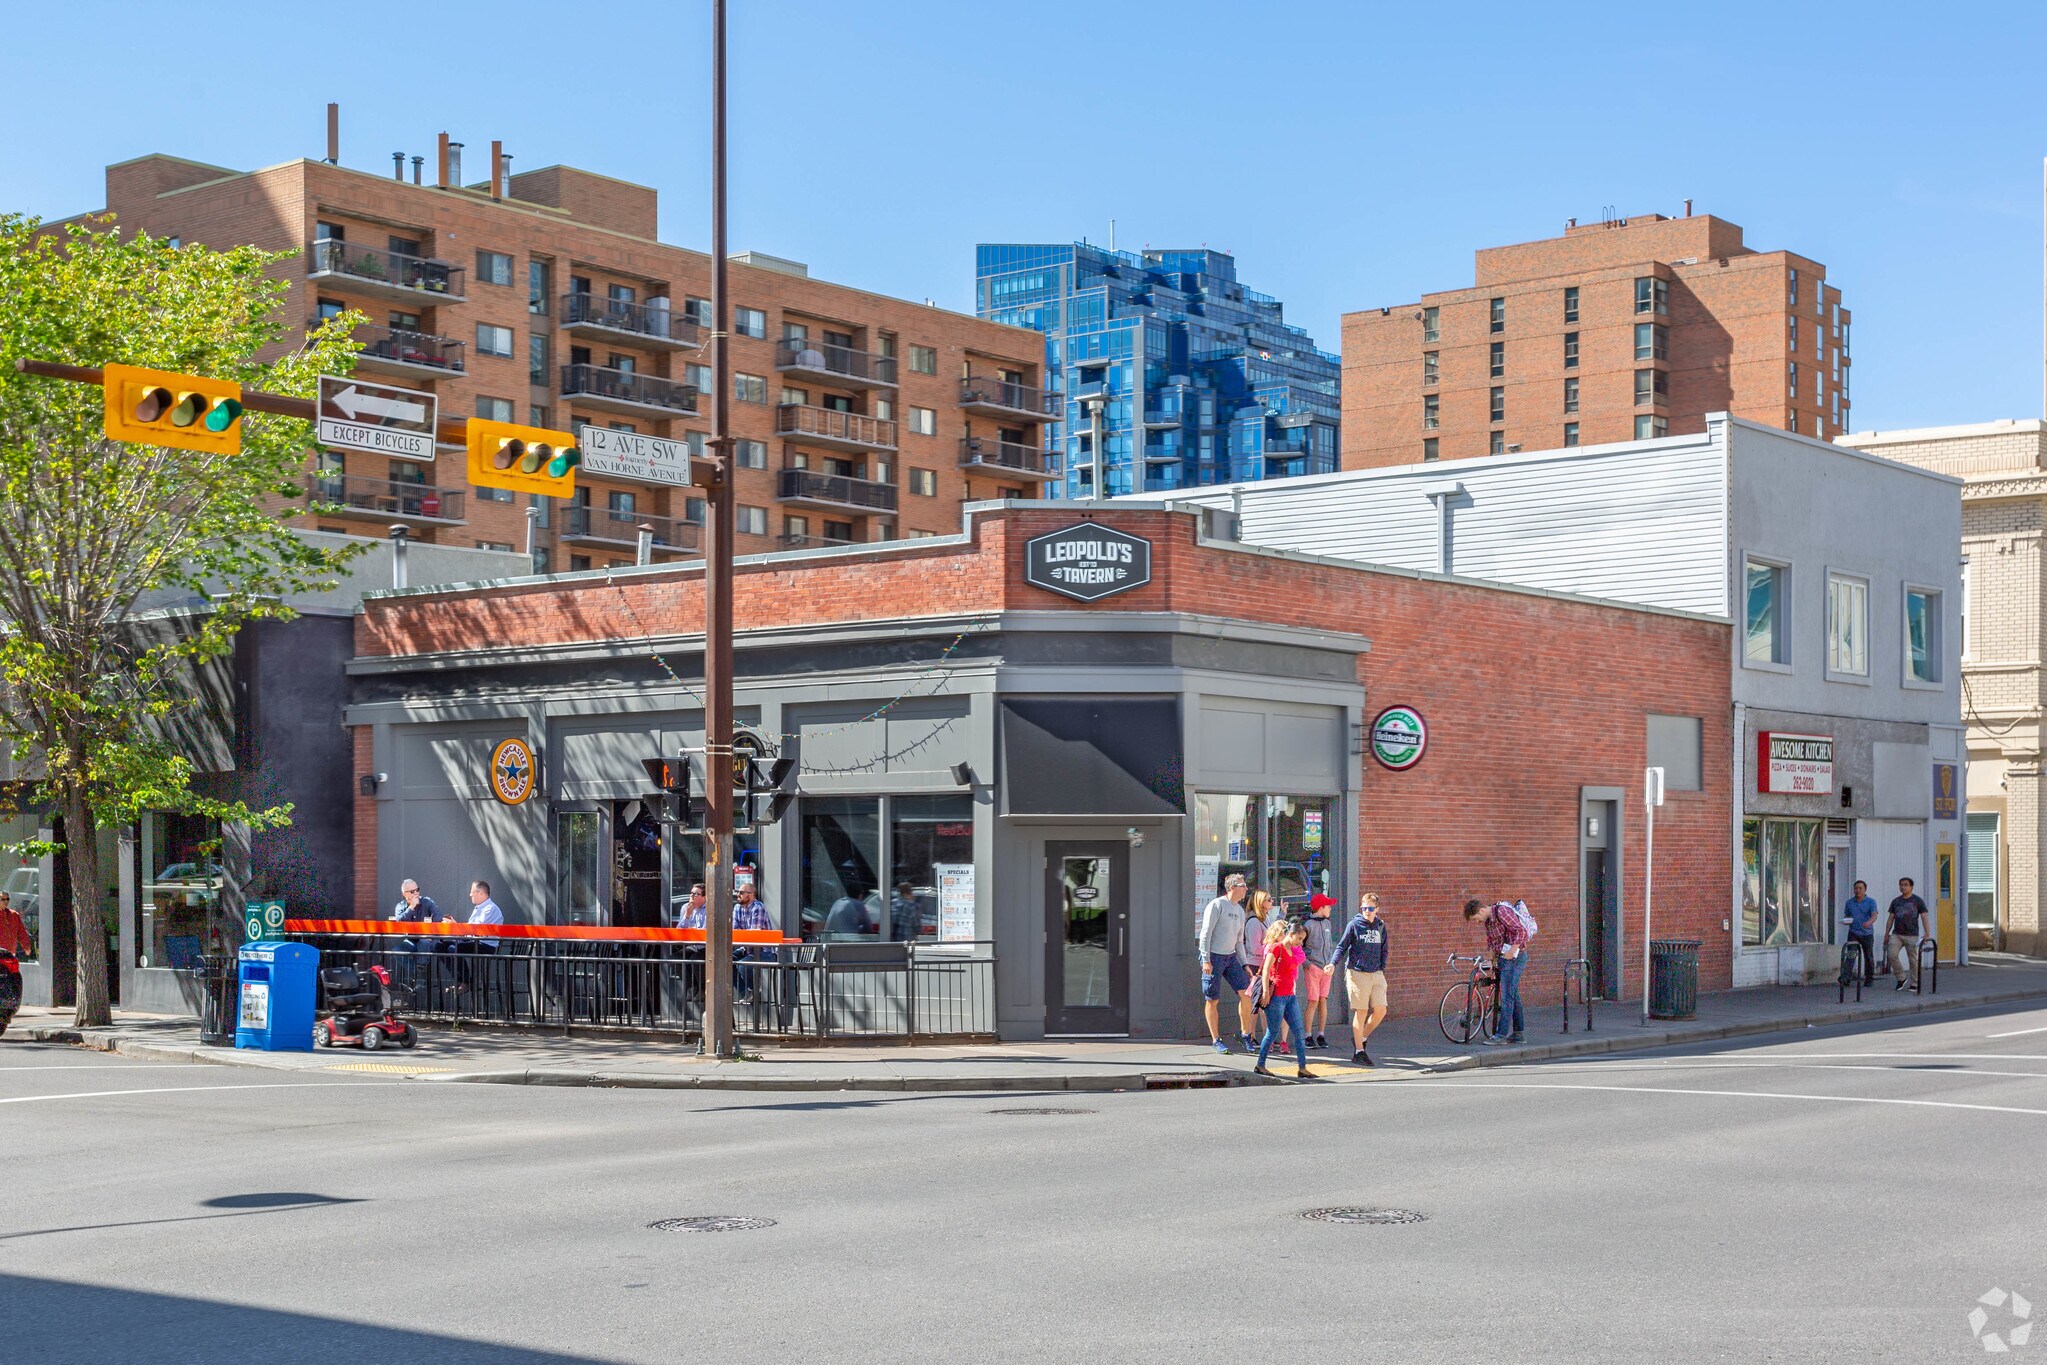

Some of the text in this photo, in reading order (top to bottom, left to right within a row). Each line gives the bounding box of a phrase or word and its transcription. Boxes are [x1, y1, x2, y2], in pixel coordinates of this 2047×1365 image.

[333, 425, 420, 452] EXCEPT BICYCLES
[591, 430, 678, 461] 12 AVE SW
[587, 457, 686, 482] VAN HORNE AVENUE
[624, 454, 648, 465] formerly
[1045, 541, 1132, 563] LEOPOLD'S
[1062, 567, 1115, 584] TAVERN
[1376, 731, 1417, 744] Heineken
[499, 745, 527, 765] NEWCASTLE
[1770, 740, 1832, 760] AWESOME KITCHEN
[1771, 763, 1831, 774] PIZZA SLICES DONAIRS SALAD
[499, 777, 527, 798] BROWN ALE
